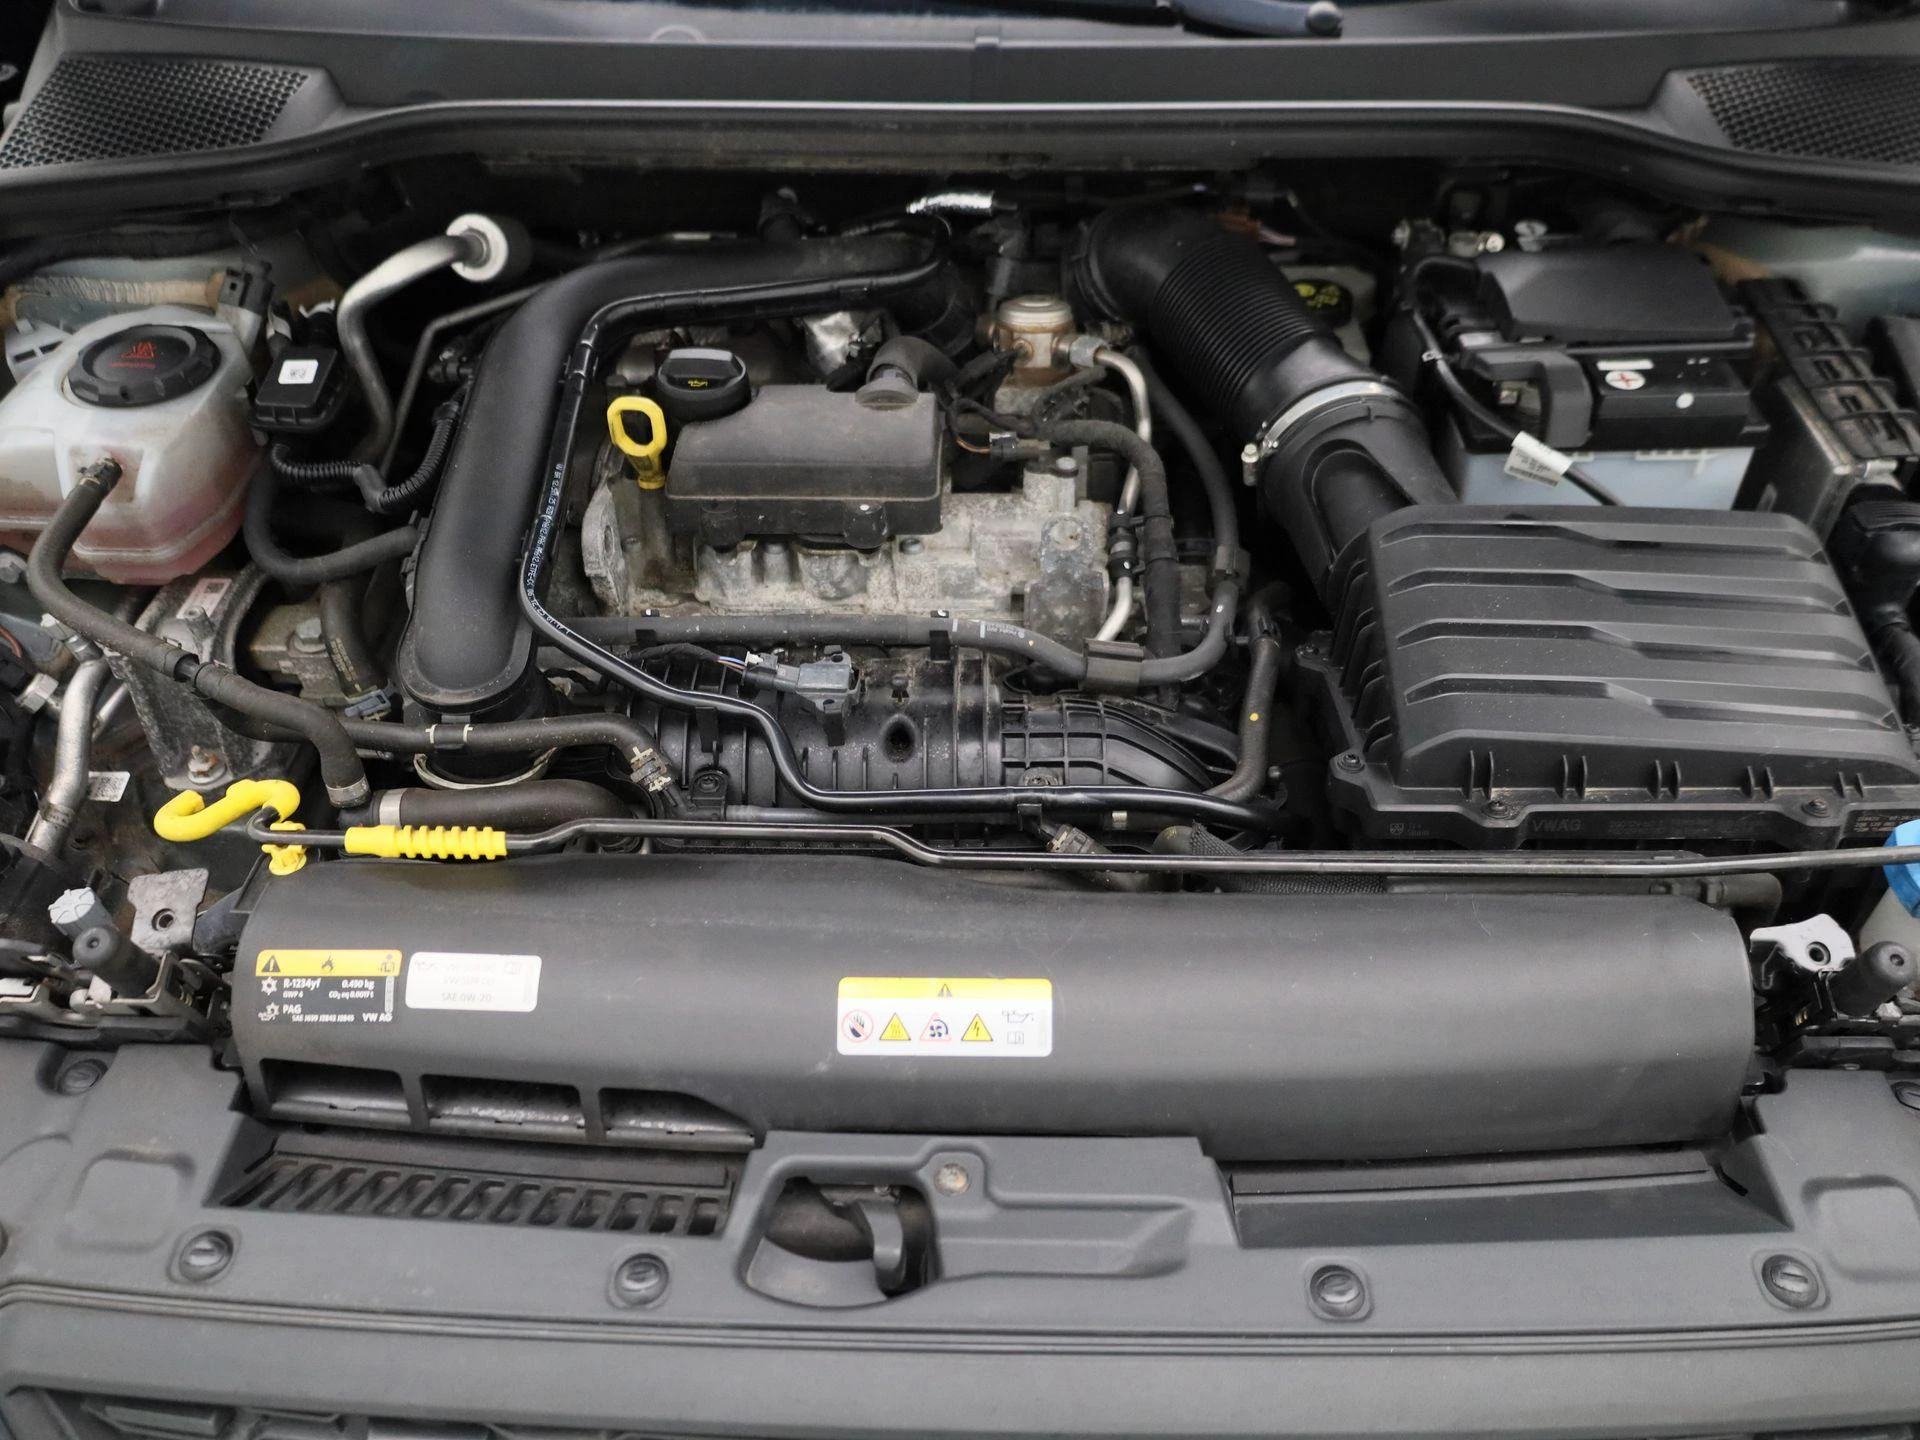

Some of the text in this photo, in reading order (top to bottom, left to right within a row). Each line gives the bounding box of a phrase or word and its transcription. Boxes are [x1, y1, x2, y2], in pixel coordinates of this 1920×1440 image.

[283, 977, 322, 990] R-1234yf
[364, 978, 374, 990] kg
[282, 1004, 302, 1014] PAG
[362, 1013, 393, 1022] VW AG
